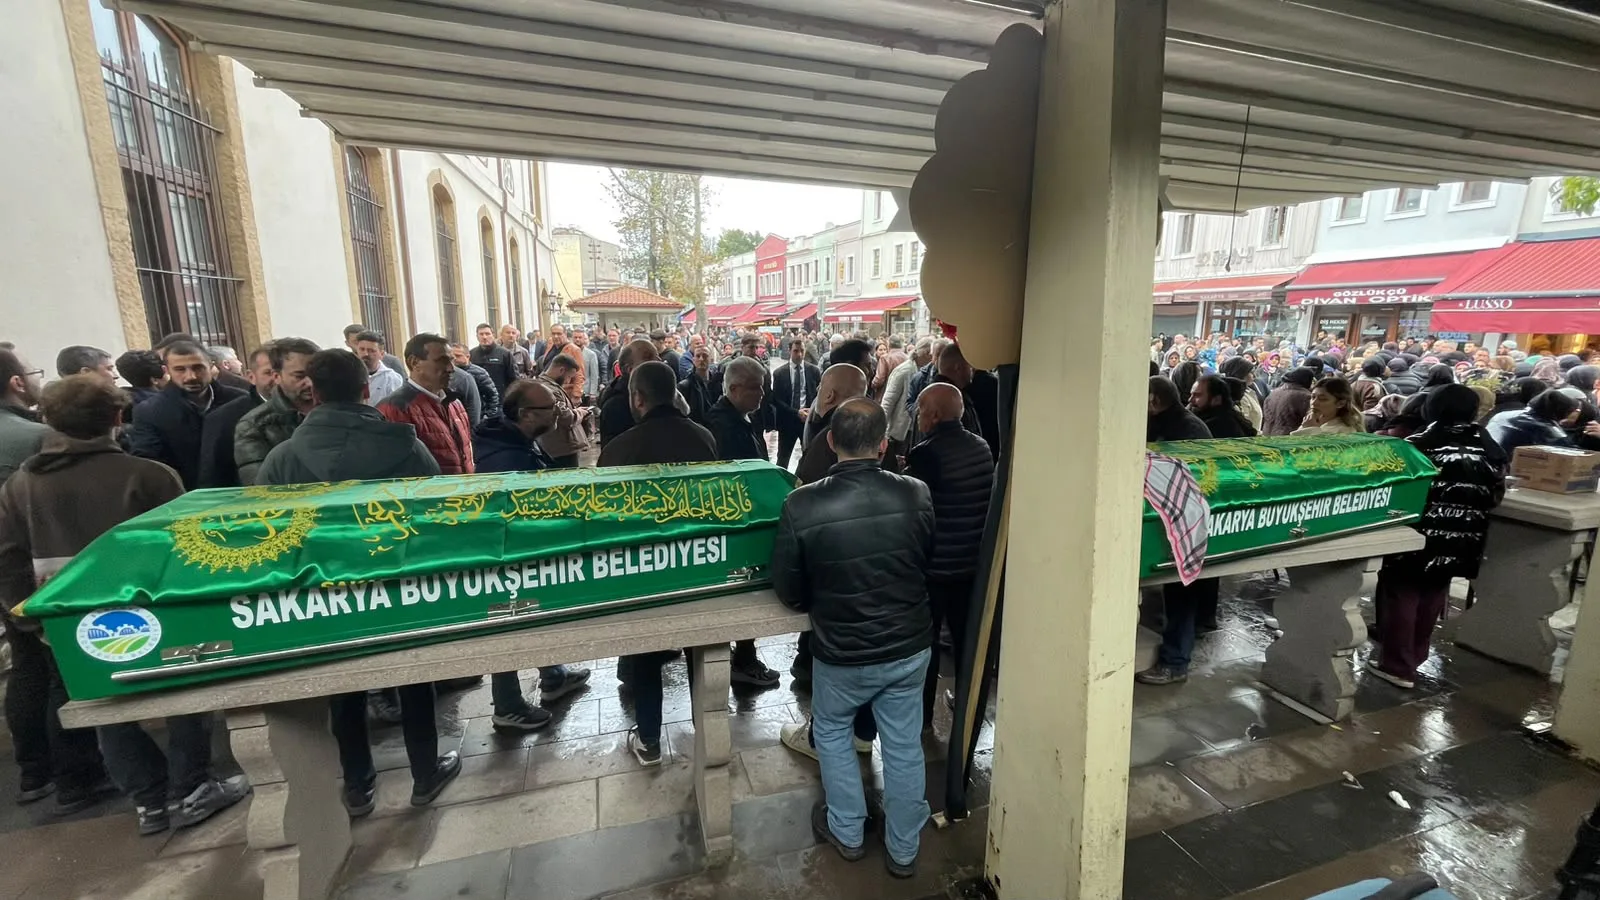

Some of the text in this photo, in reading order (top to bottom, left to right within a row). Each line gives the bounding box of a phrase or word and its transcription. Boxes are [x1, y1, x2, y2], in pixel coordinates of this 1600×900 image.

[1301, 294, 1432, 305] DİVAN OPTİK
[1464, 298, 1513, 309] LUSSO
[1207, 508, 1255, 537] AKARYA
[230, 579, 392, 628] SAKARYA
